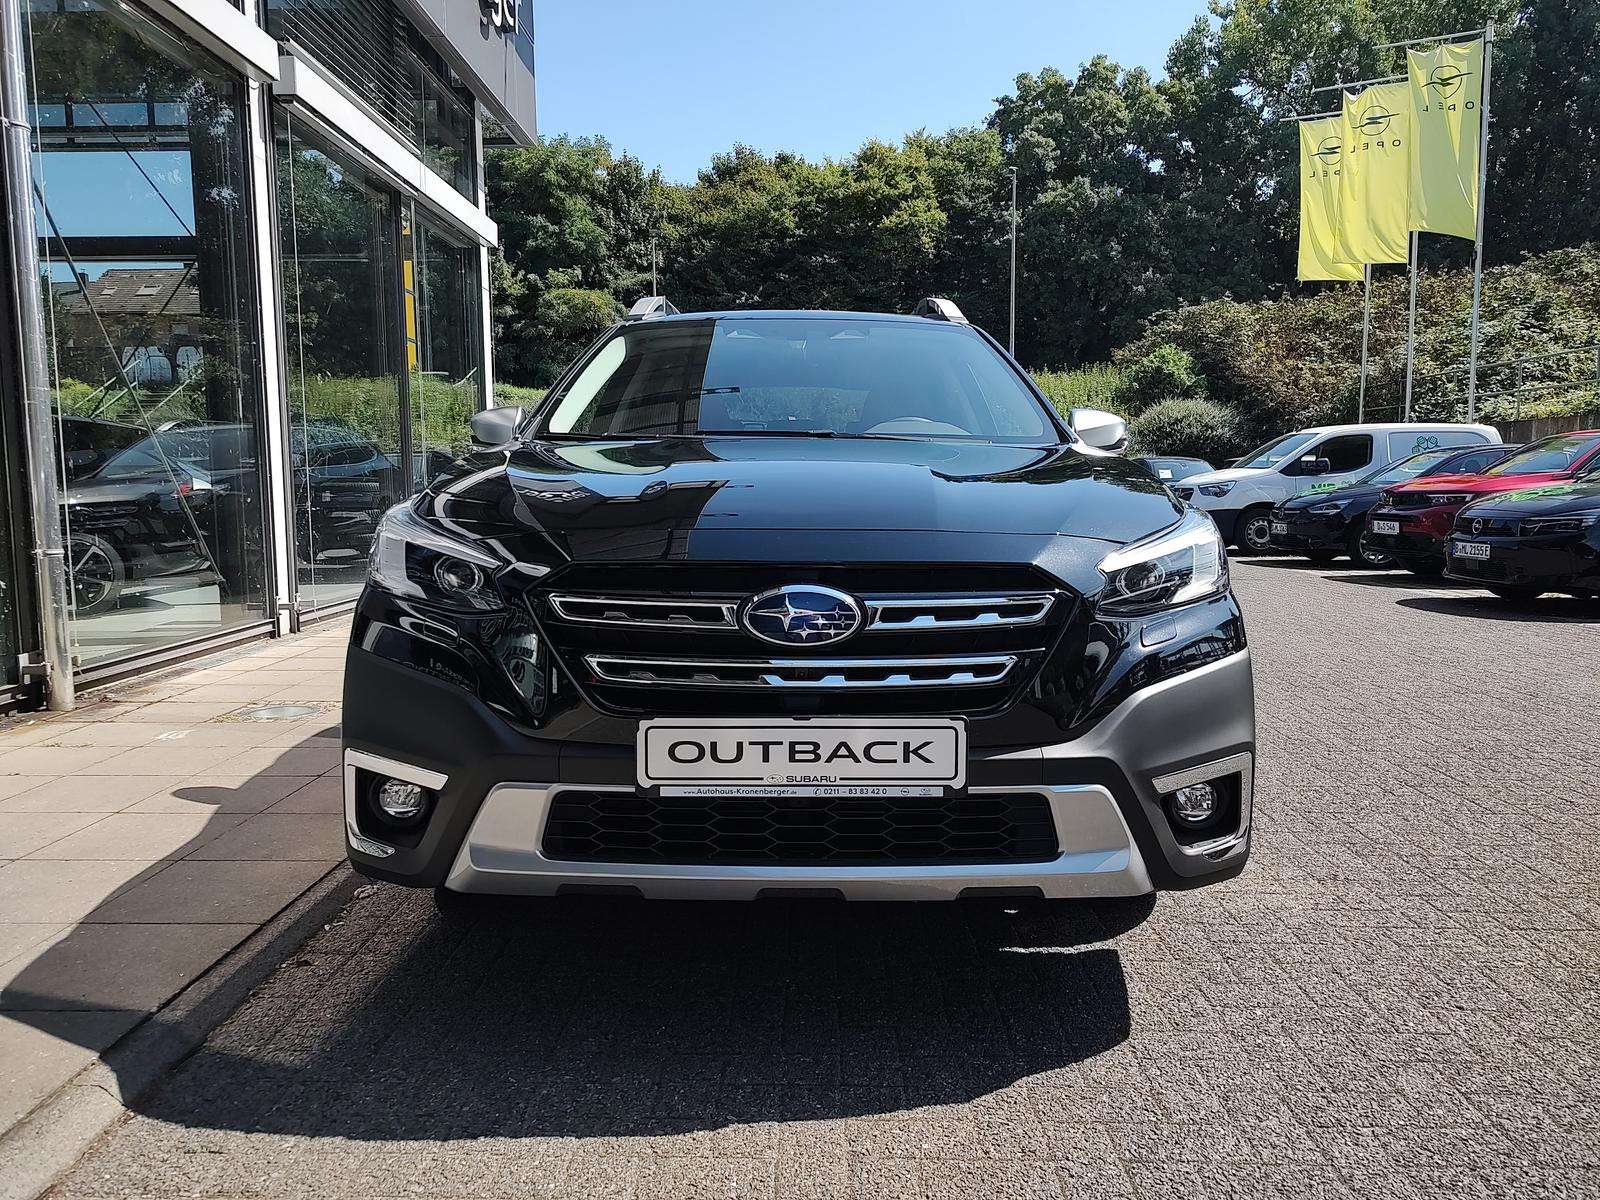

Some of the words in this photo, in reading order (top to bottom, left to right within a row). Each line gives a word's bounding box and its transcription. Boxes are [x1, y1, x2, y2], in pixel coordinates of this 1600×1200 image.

[667, 740, 935, 764] OUTBACK
[785, 775, 837, 783] SUBARU
[683, 787, 798, 797] www.Autohaus-Kronenberger.de
[823, 787, 840, 796] 0211
[848, 787, 858, 796] 83
[859, 787, 869, 796] 83
[870, 787, 880, 796] 42
[881, 787, 888, 796] 0
